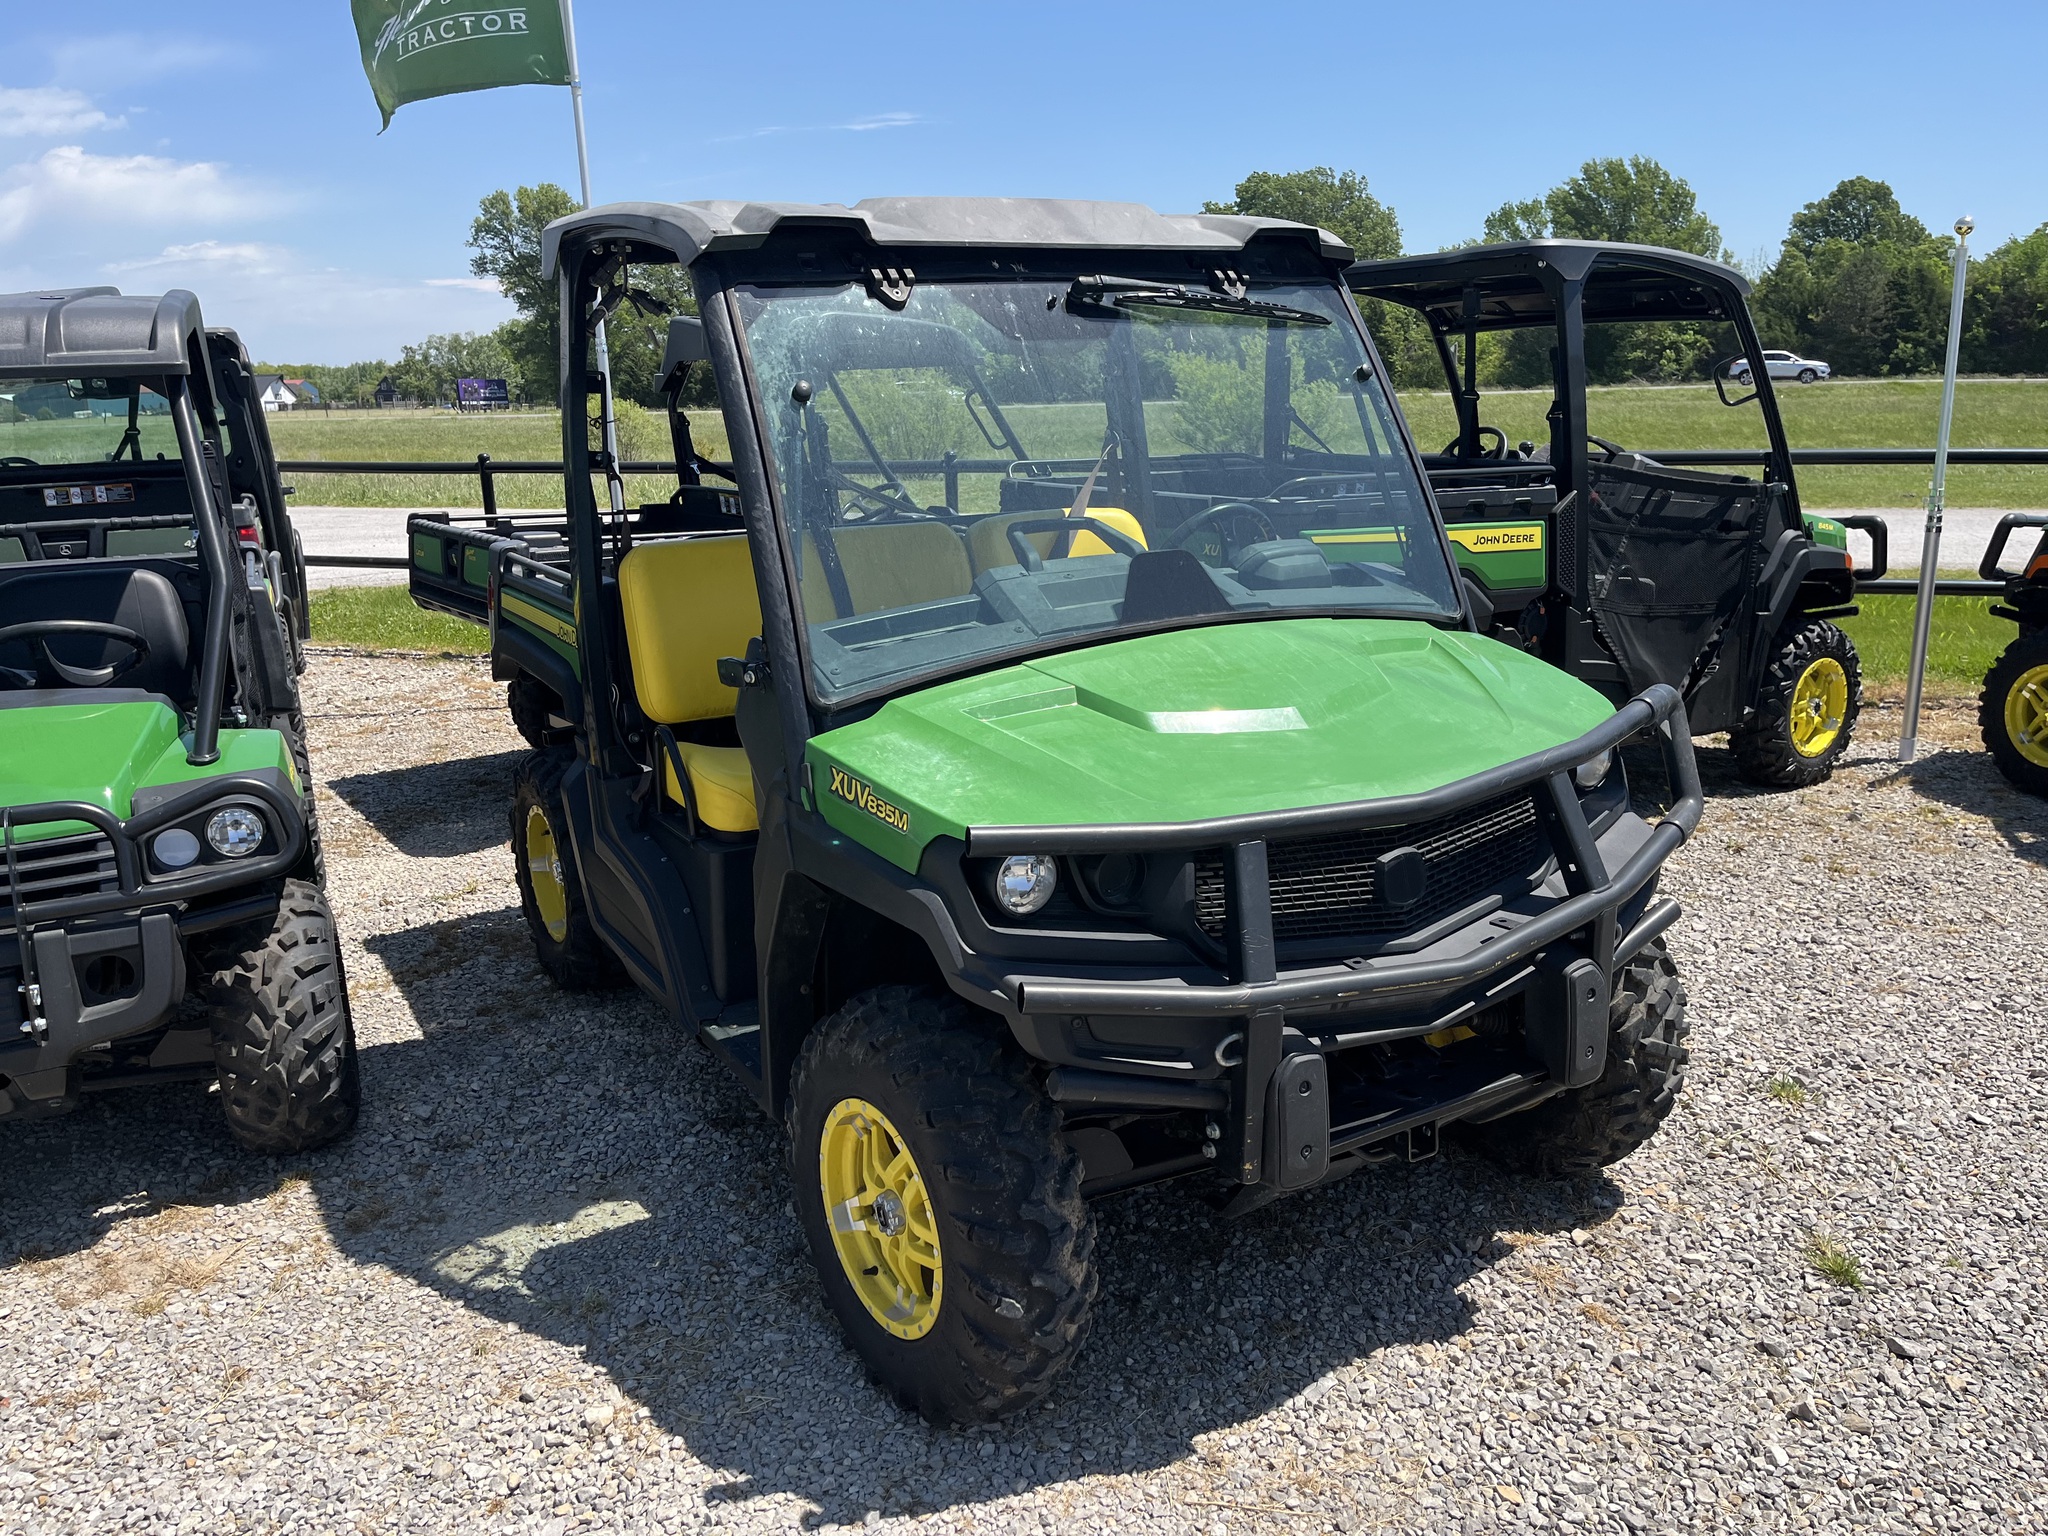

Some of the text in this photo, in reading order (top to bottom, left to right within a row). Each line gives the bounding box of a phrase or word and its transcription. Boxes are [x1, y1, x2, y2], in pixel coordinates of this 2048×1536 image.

[396, 12, 528, 55] TRACTOR
[1473, 533, 1535, 546] JOHN DEERE
[830, 766, 908, 832] XUV835M
